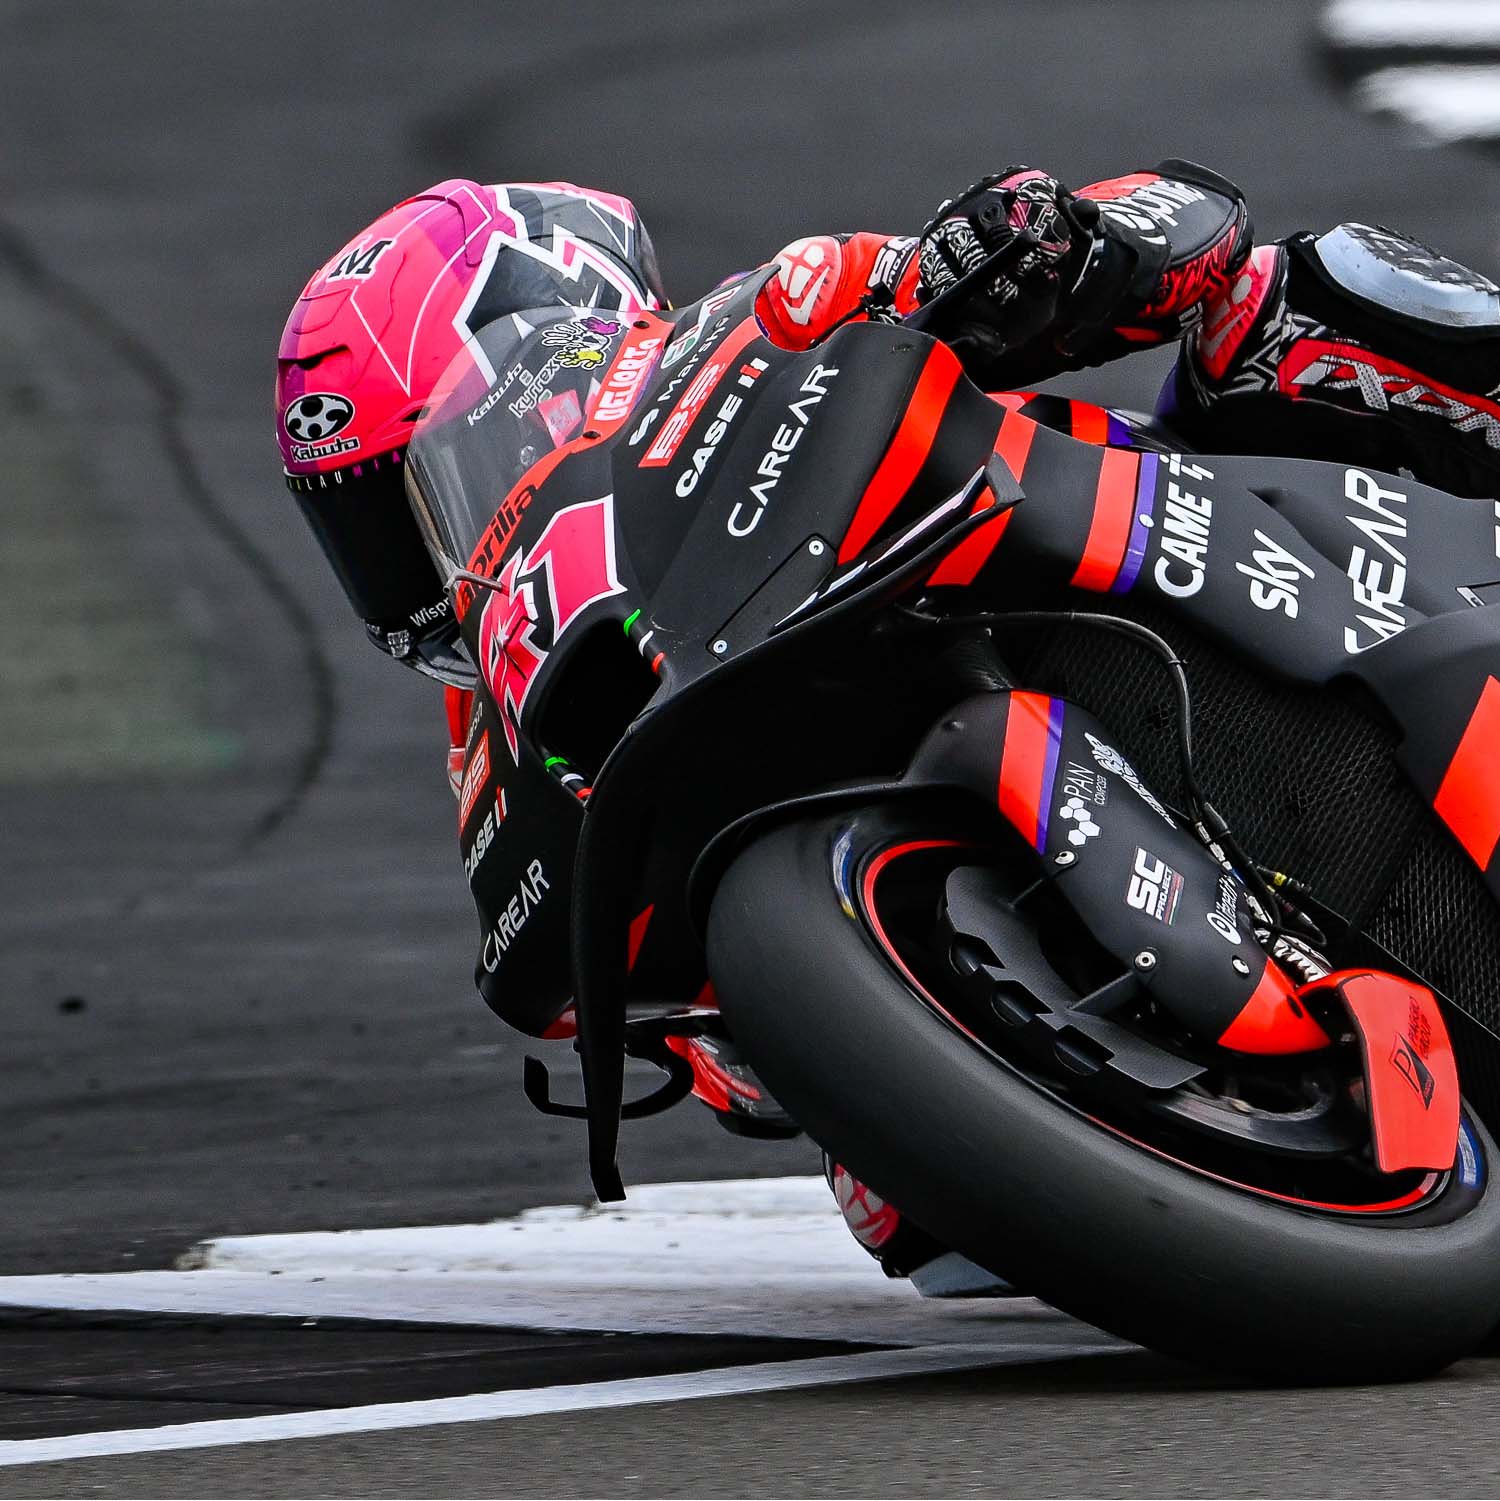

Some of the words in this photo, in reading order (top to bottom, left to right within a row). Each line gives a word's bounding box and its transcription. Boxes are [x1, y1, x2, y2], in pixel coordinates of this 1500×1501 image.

[466, 363, 523, 426] Kabuto
[291, 437, 360, 463] Kabuto
[675, 393, 744, 497] CASE
[727, 364, 840, 537] CAREAR
[1154, 481, 1214, 598] CAME
[1235, 528, 1316, 619] sky
[1064, 761, 1095, 801] PAN
[483, 858, 550, 974] CAREAR
[1127, 847, 1166, 916] SC
[1156, 864, 1174, 921] PROJECT
